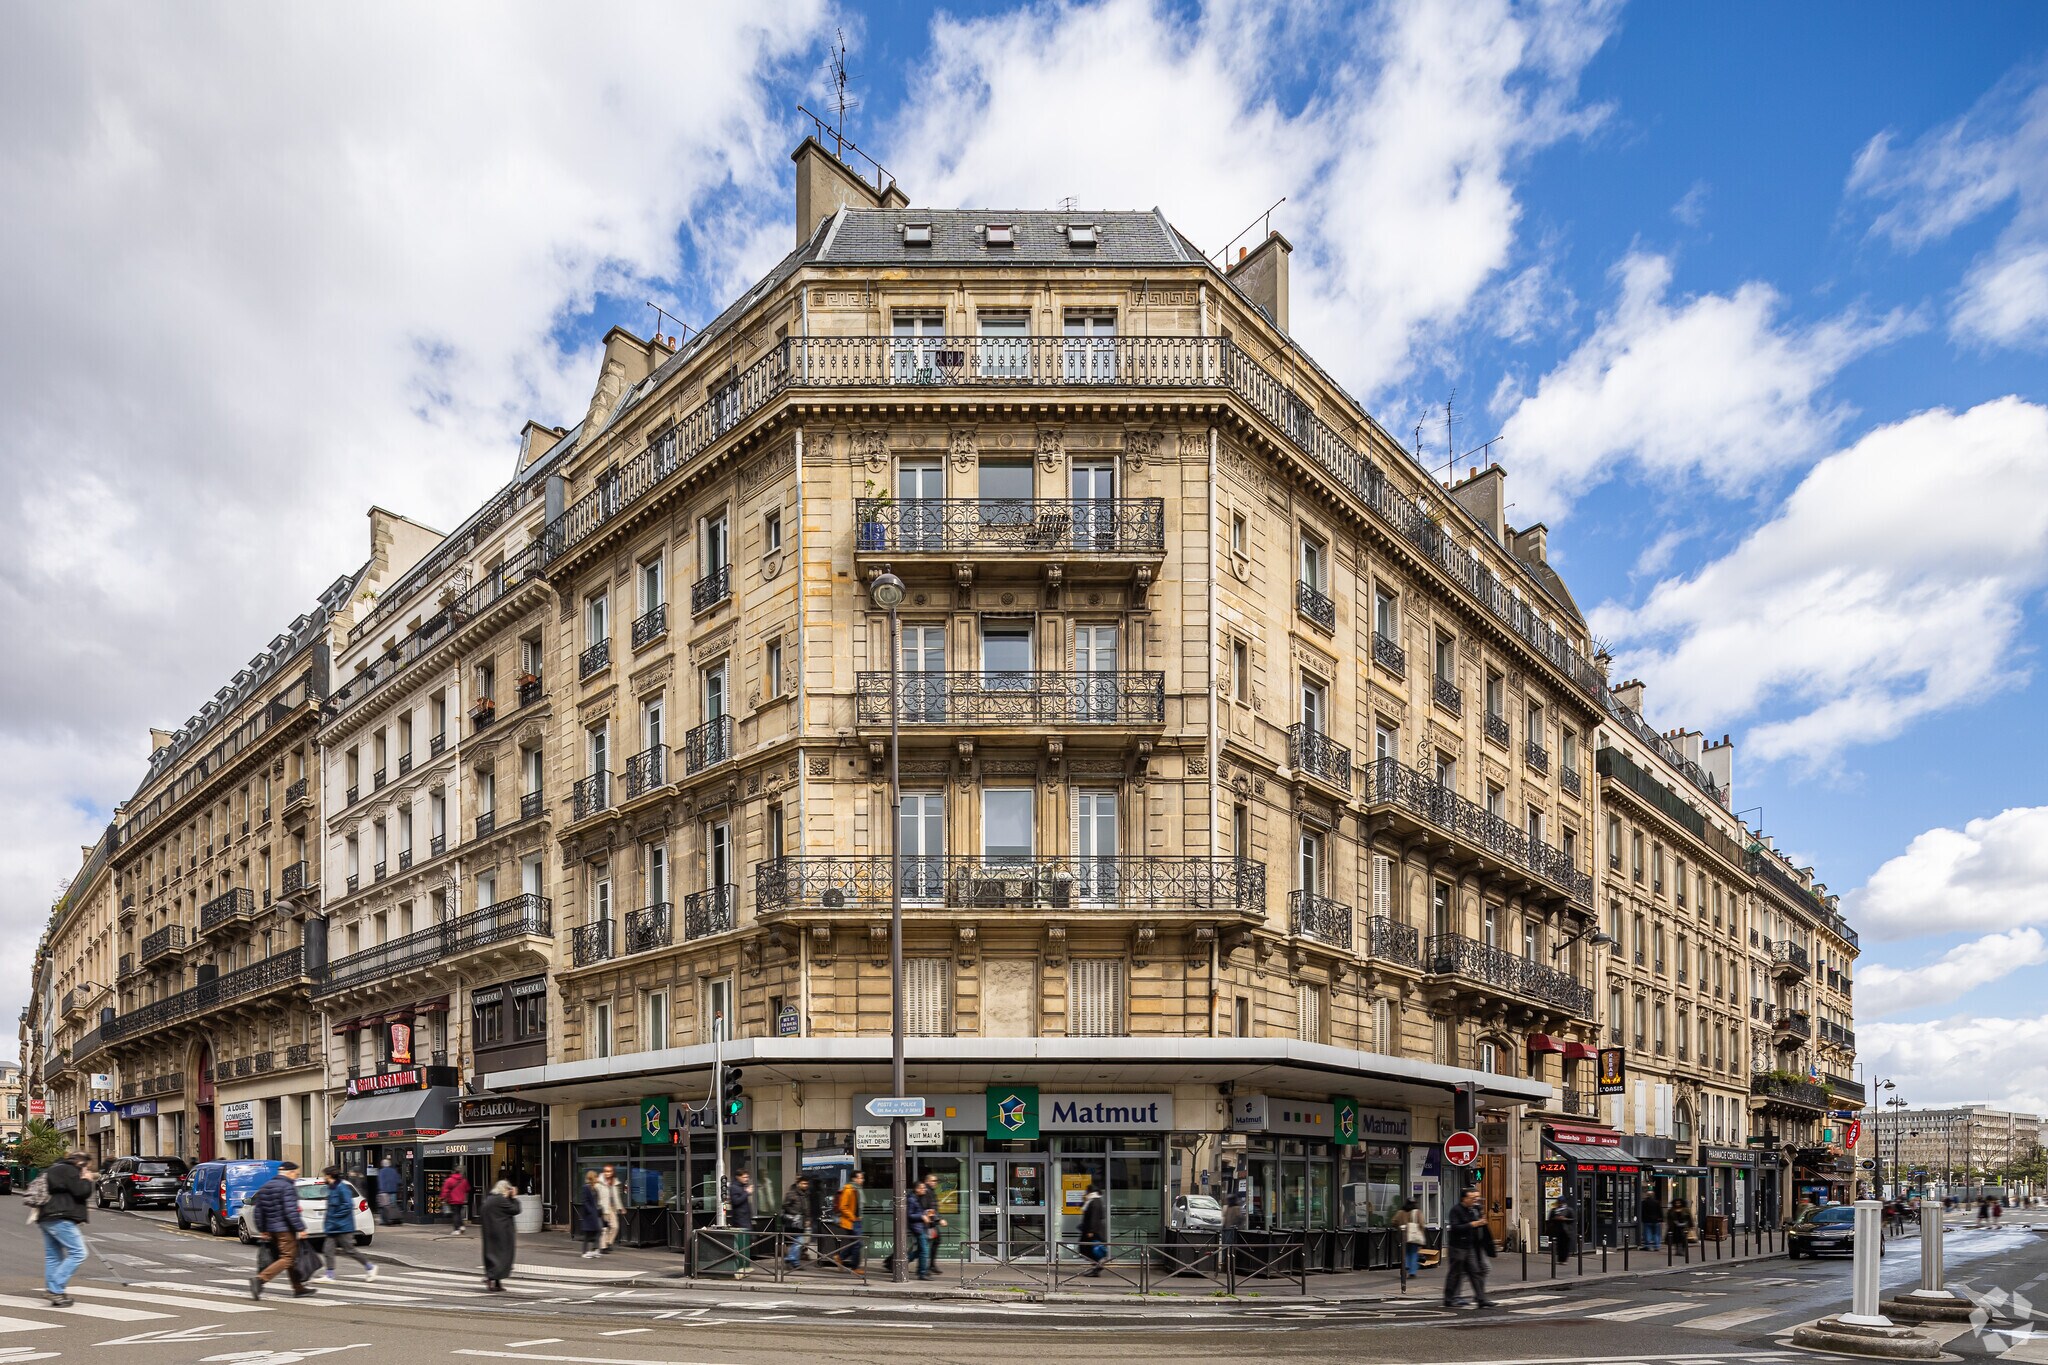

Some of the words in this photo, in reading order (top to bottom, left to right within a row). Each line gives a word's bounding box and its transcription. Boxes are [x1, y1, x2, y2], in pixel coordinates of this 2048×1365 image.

[516, 983, 541, 996] BARDOU
[476, 992, 499, 1004] BARDOU
[379, 1070, 418, 1089] ISTANBUL
[1599, 1085, 1624, 1093] L'OASIS
[232, 1103, 249, 1112] LOUER
[464, 1108, 480, 1118] CAVES
[480, 1102, 516, 1116] BARDOU
[1051, 1101, 1159, 1123] Matmut
[225, 1111, 251, 1121] COMMERCE
[1235, 1115, 1262, 1124] Matmut
[1362, 1114, 1407, 1136] Matmut
[1848, 1124, 1857, 1145] TABAC
[445, 1144, 469, 1154] BARDOU
[1708, 1150, 1727, 1160] PHARMACIE
[1727, 1152, 1743, 1161] CENTRALE
[1540, 1164, 1566, 1172] PIZZA
